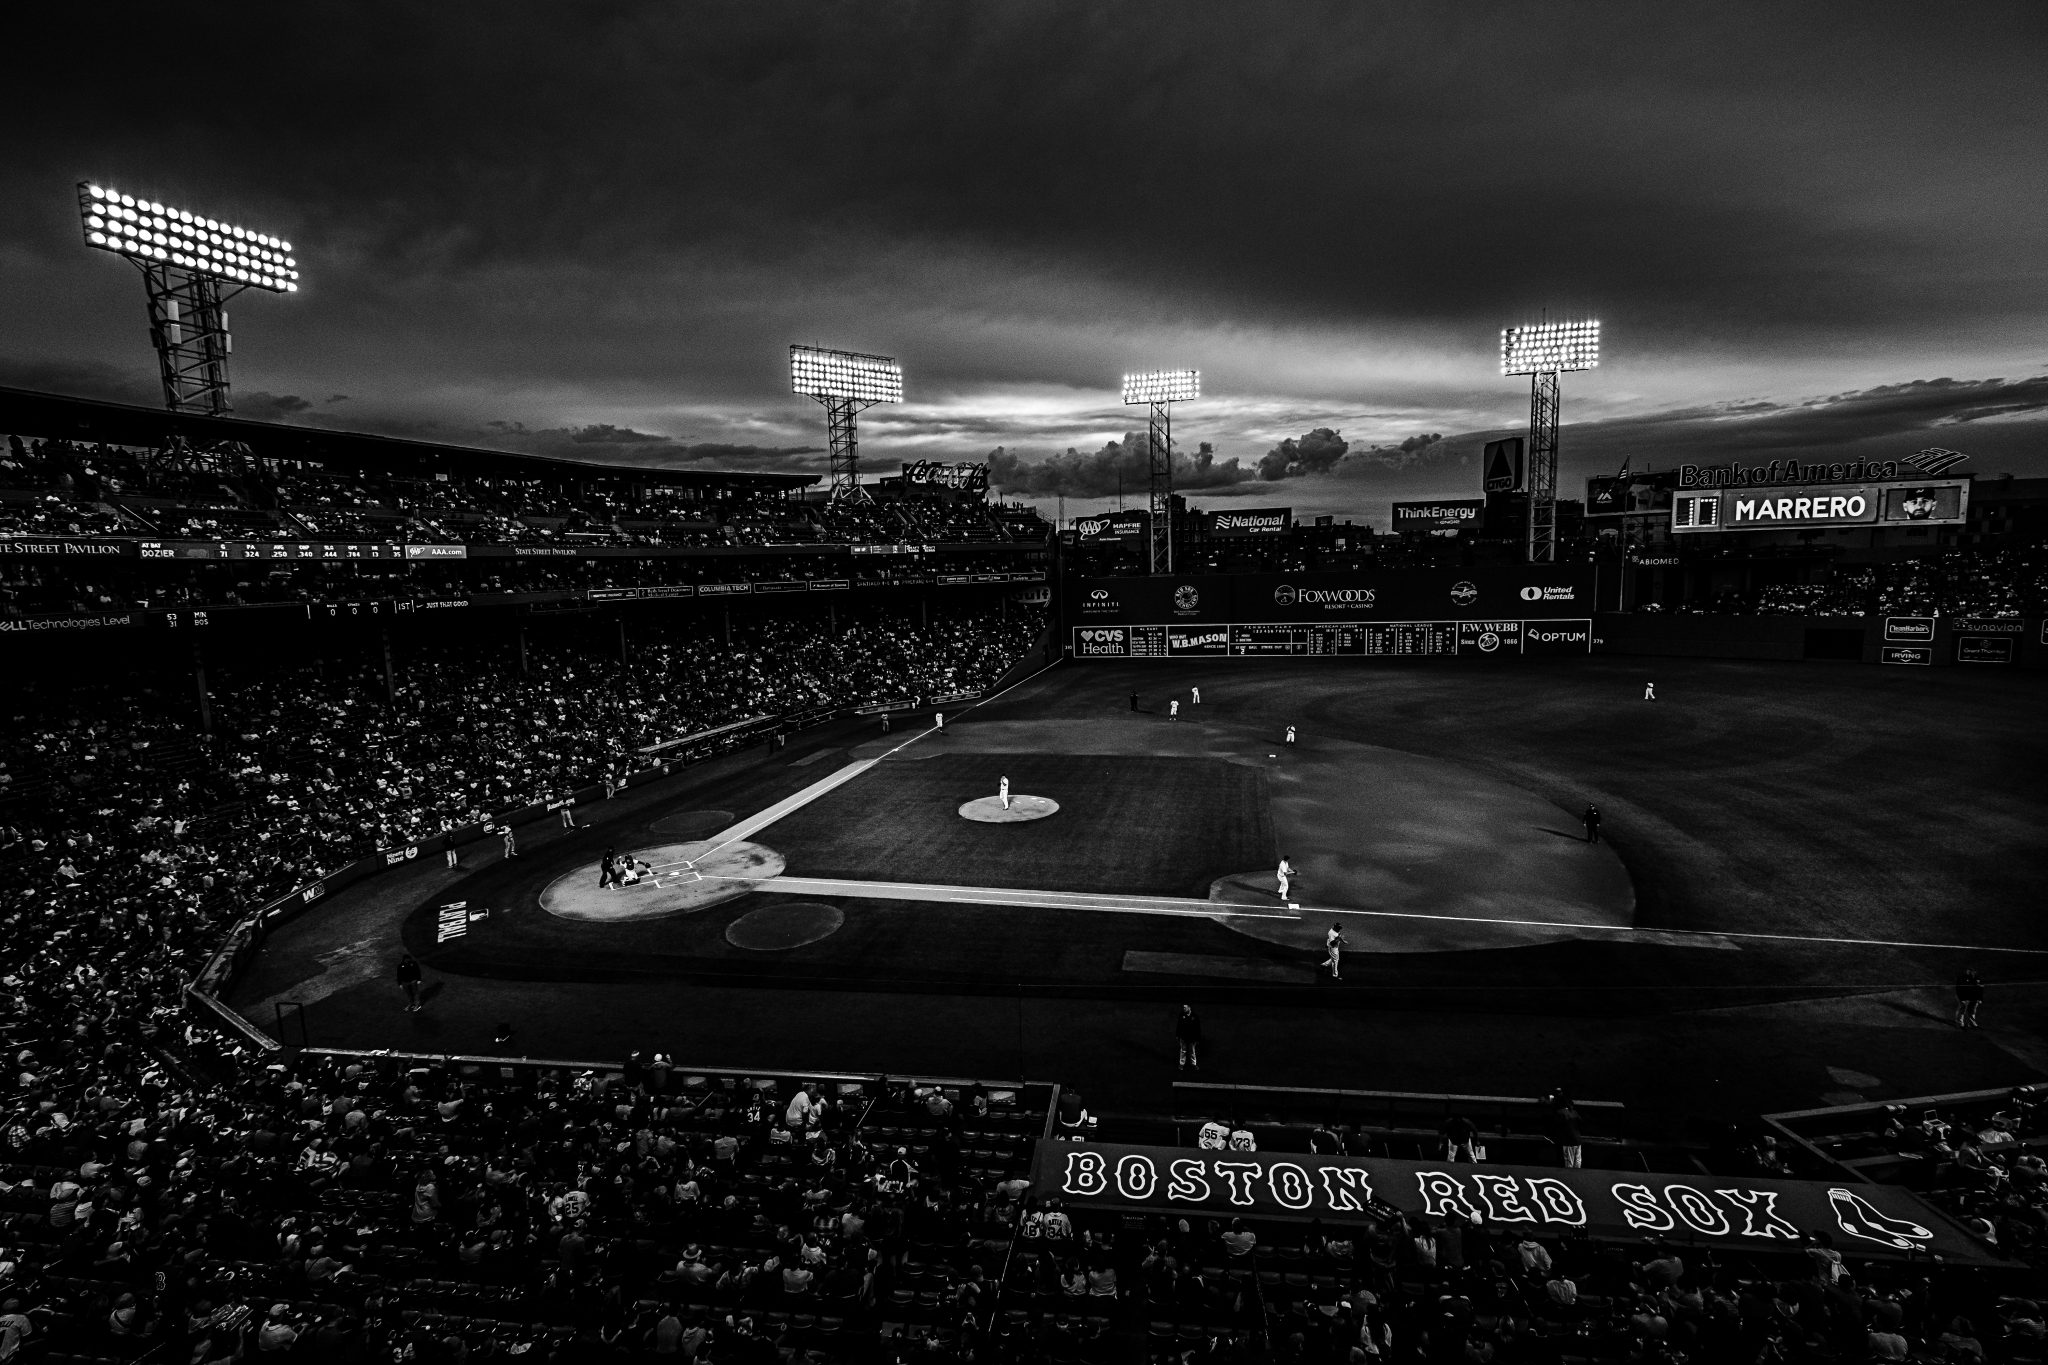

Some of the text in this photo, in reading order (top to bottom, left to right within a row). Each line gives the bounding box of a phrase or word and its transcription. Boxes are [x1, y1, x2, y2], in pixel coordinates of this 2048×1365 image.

[1680, 456, 1898, 487] Bank of America
[1487, 478, 1512, 490] CITGO
[1398, 506, 1476, 519] ThinkEnergy
[1735, 495, 1866, 521] MARRERO
[1231, 514, 1284, 527] National
[14, 542, 60, 554] STREET
[64, 543, 120, 554] PAVILION
[141, 550, 175, 558] DOZIER
[700, 585, 731, 593] COLUMBIA
[1298, 589, 1376, 602] FOXWOODS
[330, 606, 378, 616] 0 0 0
[26, 617, 100, 630] Technologies
[103, 615, 130, 626] Level
[1462, 623, 1518, 632] F.W. WEBB
[1095, 630, 1124, 641] CVS
[1541, 633, 1586, 641] OPTUM
[1083, 643, 1124, 654] Health
[1891, 652, 1921, 660] IRVING
[387, 856, 404, 865] Nine
[747, 1111, 760, 1122] 34
[1236, 1138, 1250, 1147] 73
[1062, 1152, 1800, 1239] BOSTON RED SOX
[565, 1204, 580, 1215] 25
[1048, 1227, 1062, 1238] 34
